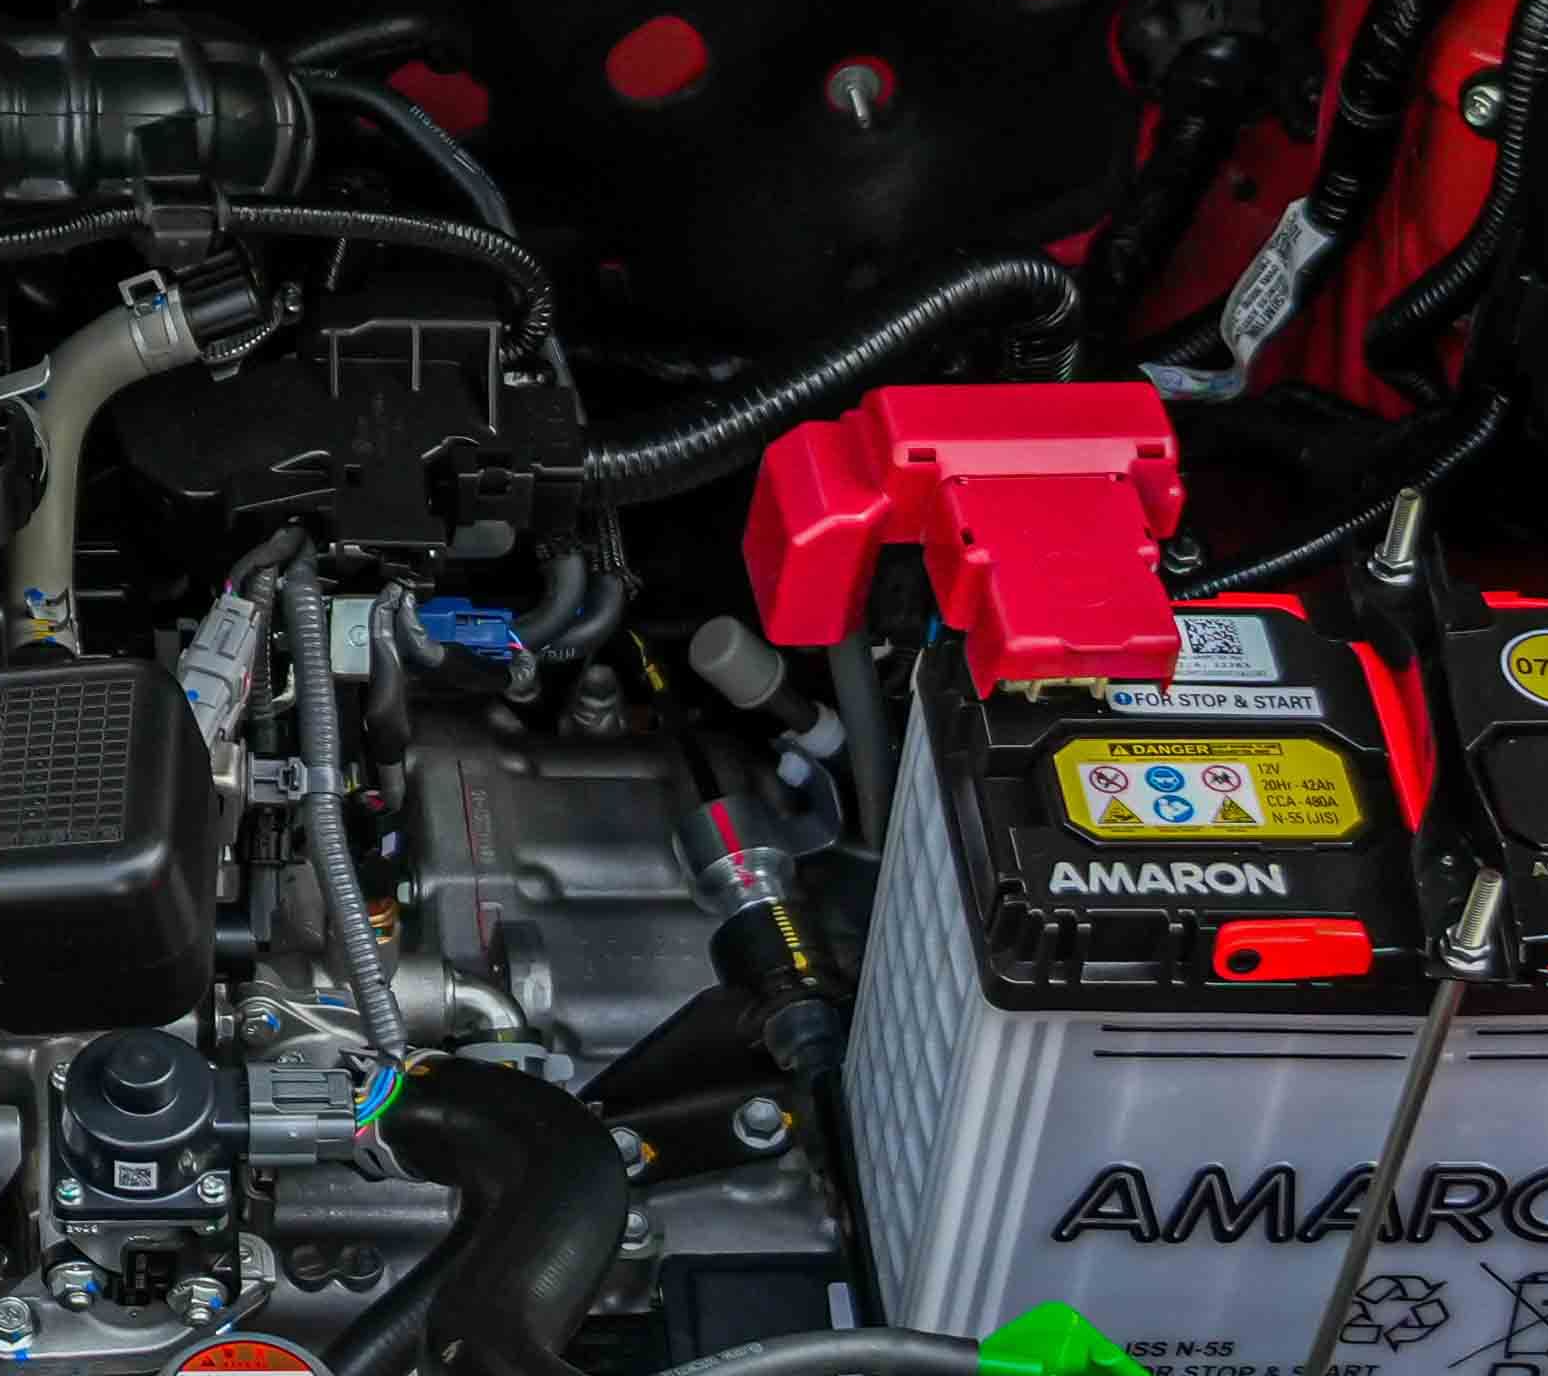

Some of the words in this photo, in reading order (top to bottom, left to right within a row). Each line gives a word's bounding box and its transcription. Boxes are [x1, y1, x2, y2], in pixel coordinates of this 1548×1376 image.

[1134, 692, 1172, 708] FOR
[1177, 693, 1227, 709] STOP
[1234, 694, 1248, 709] &
[1255, 695, 1313, 710] START
[1132, 743, 1209, 755] DANGER
[1257, 762, 1280, 775] 12V
[1261, 778, 1292, 791] 20Hr
[1266, 795, 1296, 807] CCA
[1271, 811, 1305, 824] N-55
[1306, 811, 1340, 825] (JIS)
[1048, 861, 1288, 896] AMARON
[1175, 1341, 1235, 1358] N-55
